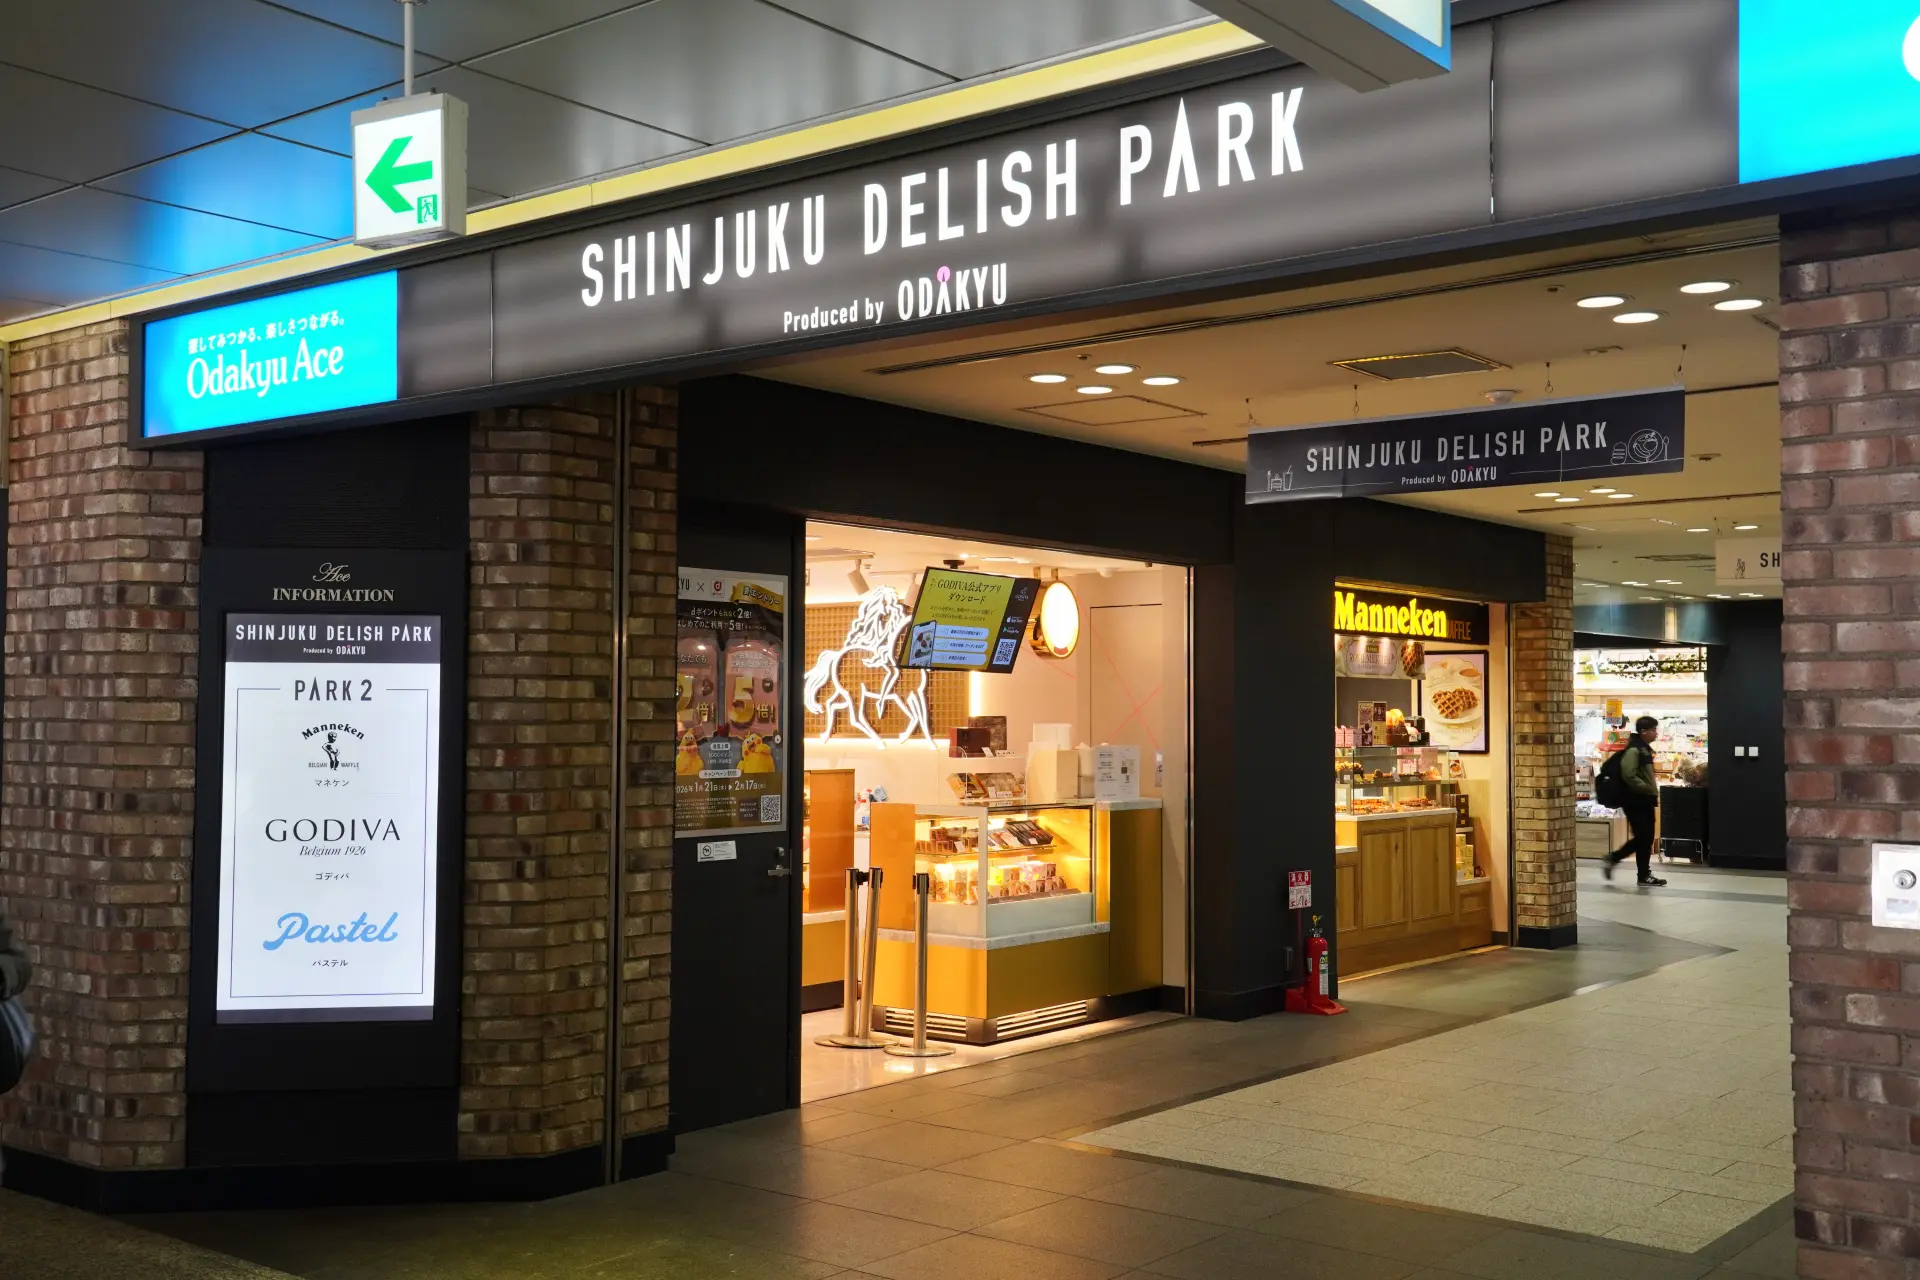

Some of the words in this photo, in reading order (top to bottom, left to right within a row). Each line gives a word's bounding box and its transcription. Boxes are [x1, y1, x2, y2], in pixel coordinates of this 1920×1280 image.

[581, 194, 825, 307] SHINJUKU
[864, 138, 1077, 255] DELISH
[1120, 87, 1304, 206] PARK
[784, 299, 858, 333] Produced
[864, 297, 885, 326] by
[897, 263, 1008, 321] ODAKYU
[186, 349, 288, 399] Odakyu
[292, 337, 344, 382] Ace
[1306, 436, 1422, 473] SHINJUKU
[1437, 429, 1525, 463] DELISH
[1540, 421, 1608, 454] PARK
[1401, 475, 1435, 486] Produced
[1436, 475, 1446, 486] by
[1451, 465, 1497, 484] ODAKYU
[312, 562, 351, 583] Ace
[272, 587, 395, 602] INFORMATION
[937, 579, 1002, 594] GODIVA公式アプリ
[1334, 590, 1447, 639] Manneken
[235, 624, 317, 641] SHINJUKU
[326, 625, 383, 642] DELISH
[391, 623, 432, 642] PARK
[326, 647, 333, 655] by
[336, 644, 366, 655] ODAKYU
[294, 676, 352, 701] PARK
[360, 679, 373, 701] 2
[301, 723, 365, 740] Manneken
[314, 778, 350, 787] マネケン
[265, 818, 401, 843] GODIVA
[299, 845, 341, 857] Belgium
[344, 846, 366, 856] 1926
[315, 871, 350, 881] ゴディバ
[262, 911, 399, 951] Pastel
[312, 959, 349, 968] パステル
